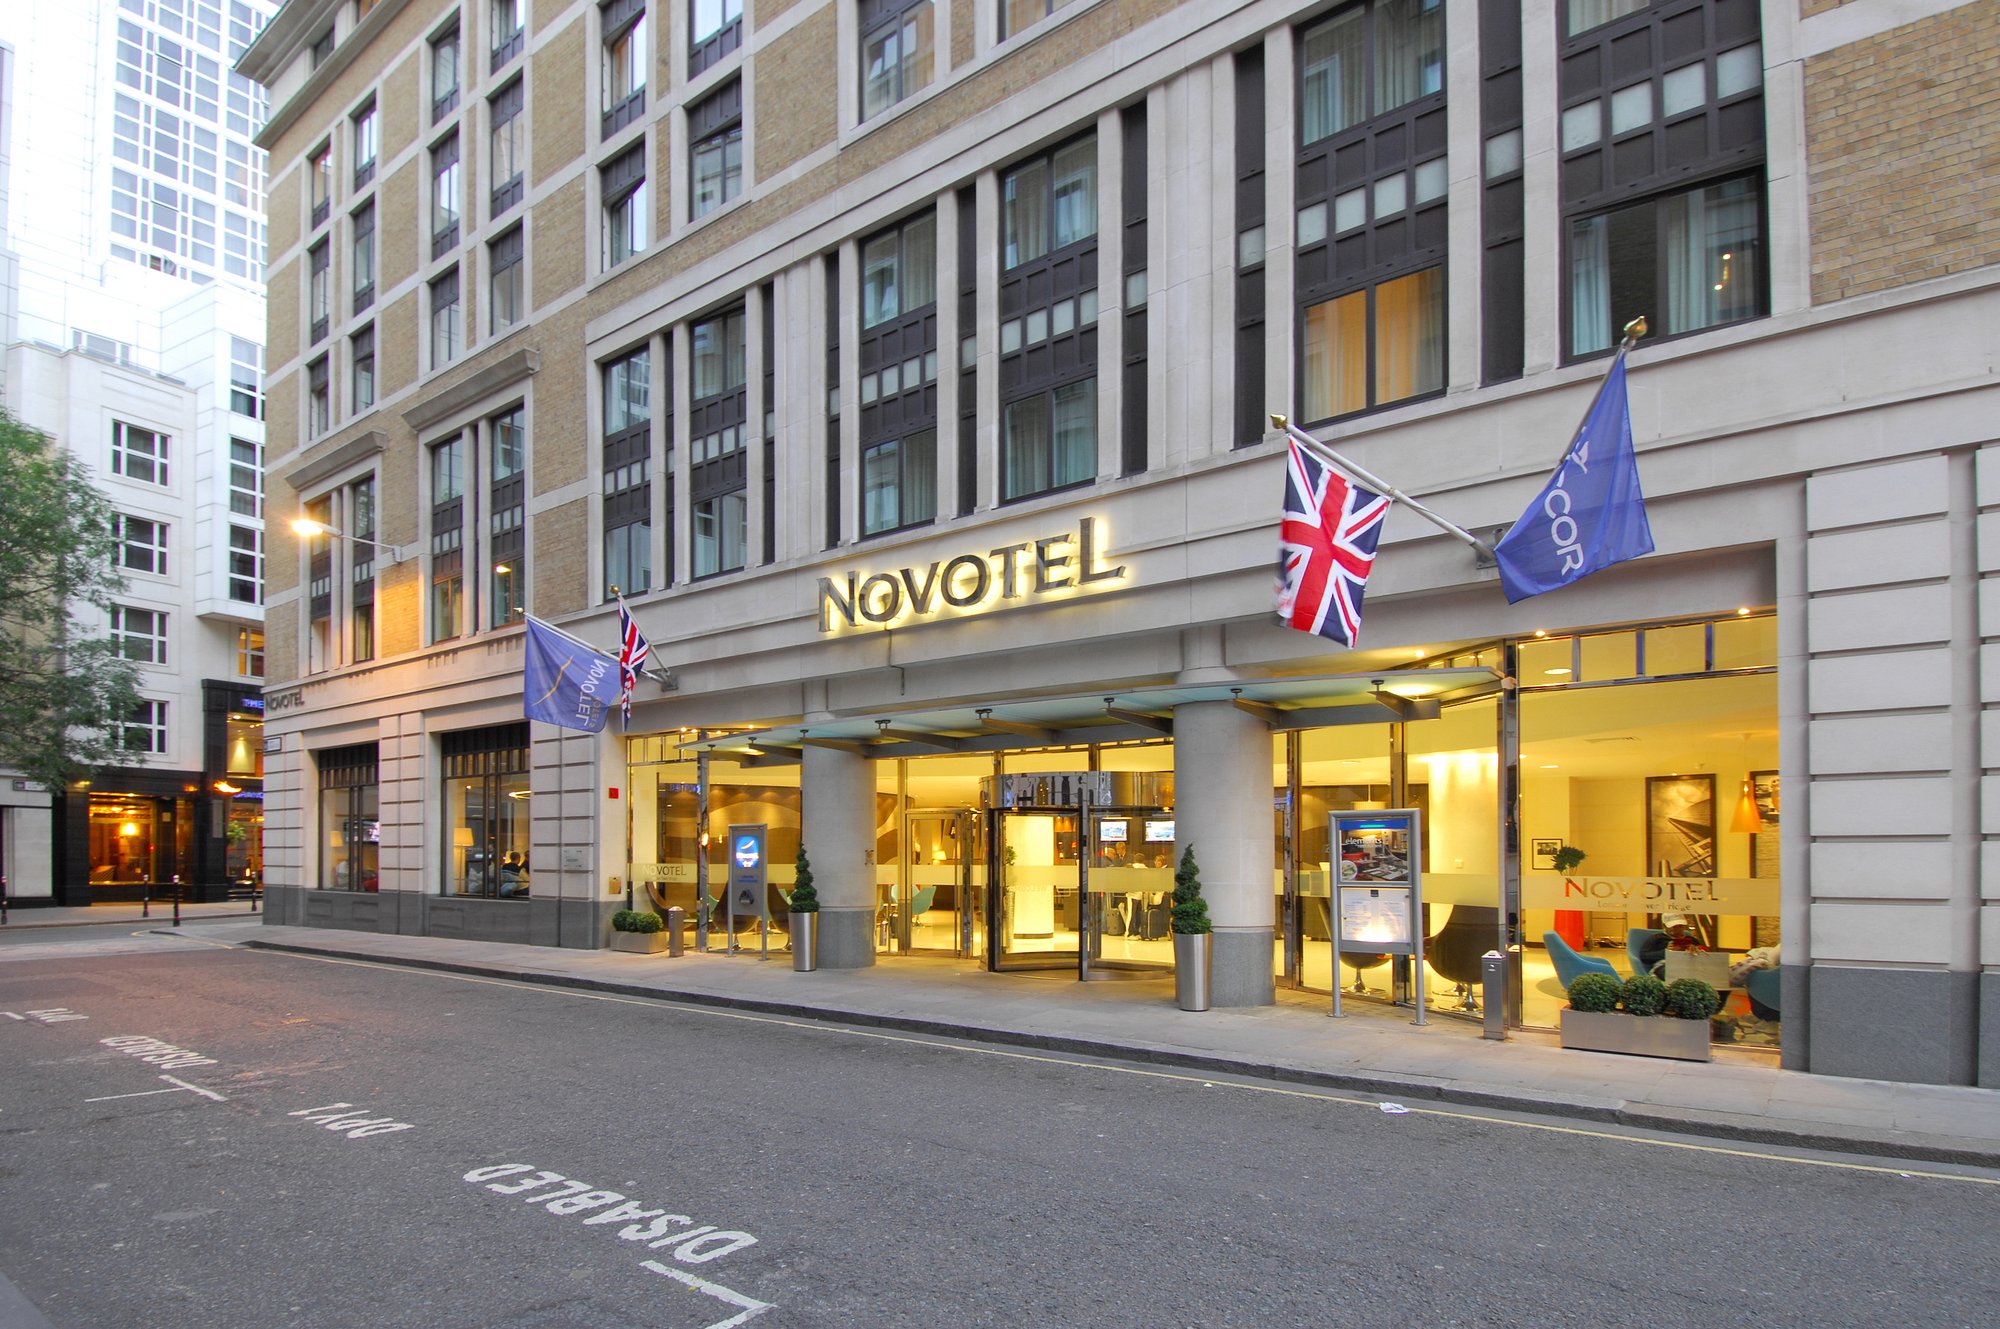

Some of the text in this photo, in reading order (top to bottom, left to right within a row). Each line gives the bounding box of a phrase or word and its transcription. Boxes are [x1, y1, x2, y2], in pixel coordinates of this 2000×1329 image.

[816, 516, 1126, 633] NOVOTEL
[265, 687, 305, 712] NOVOTEL
[642, 865, 687, 876] NOVOTEL
[1565, 877, 1719, 901] NOVOTEL
[100, 1036, 218, 1069] DISABLED
[463, 1162, 760, 1264] DISABLED
